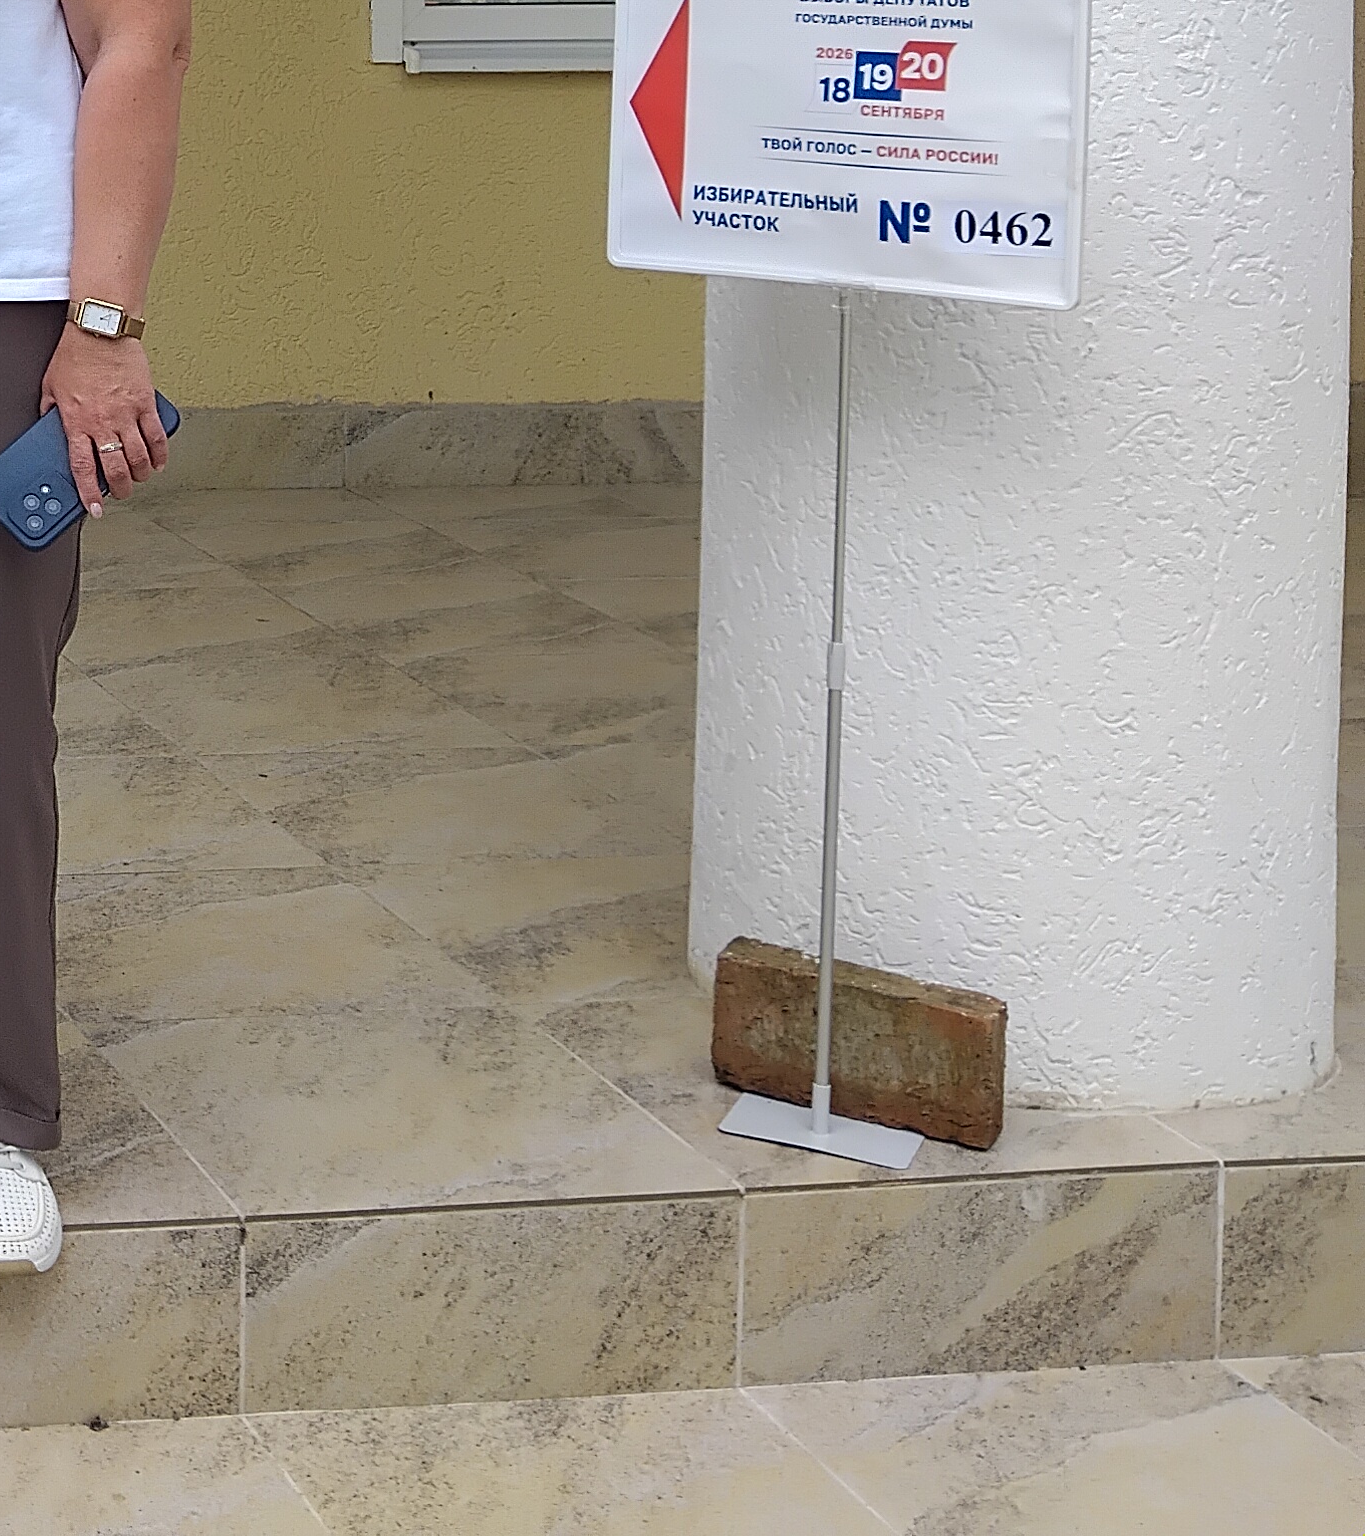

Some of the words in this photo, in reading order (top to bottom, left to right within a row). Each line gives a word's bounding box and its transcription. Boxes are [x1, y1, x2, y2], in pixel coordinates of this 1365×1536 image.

[795, 13, 927, 30] ГОСУДАРСТВЕННОЙ
[930, 17, 974, 31] ДУМЫ
[815, 47, 854, 60] 2026
[819, 76, 850, 104] 18
[859, 63, 894, 91] 19
[901, 52, 944, 81] 20
[860, 104, 945, 122] СЕНТЯБРЯ
[762, 136, 802, 152] ТВОЙ
[806, 141, 857, 156] ГОЛОС
[876, 145, 921, 160] СИЛА
[926, 148, 998, 166] РОССИИ!
[693, 184, 858, 214] ИЗБИРАТЕЛЬНЫЙ
[879, 200, 931, 244] №
[954, 209, 1054, 248] 0462
[693, 209, 780, 233] УЧАСТОК
